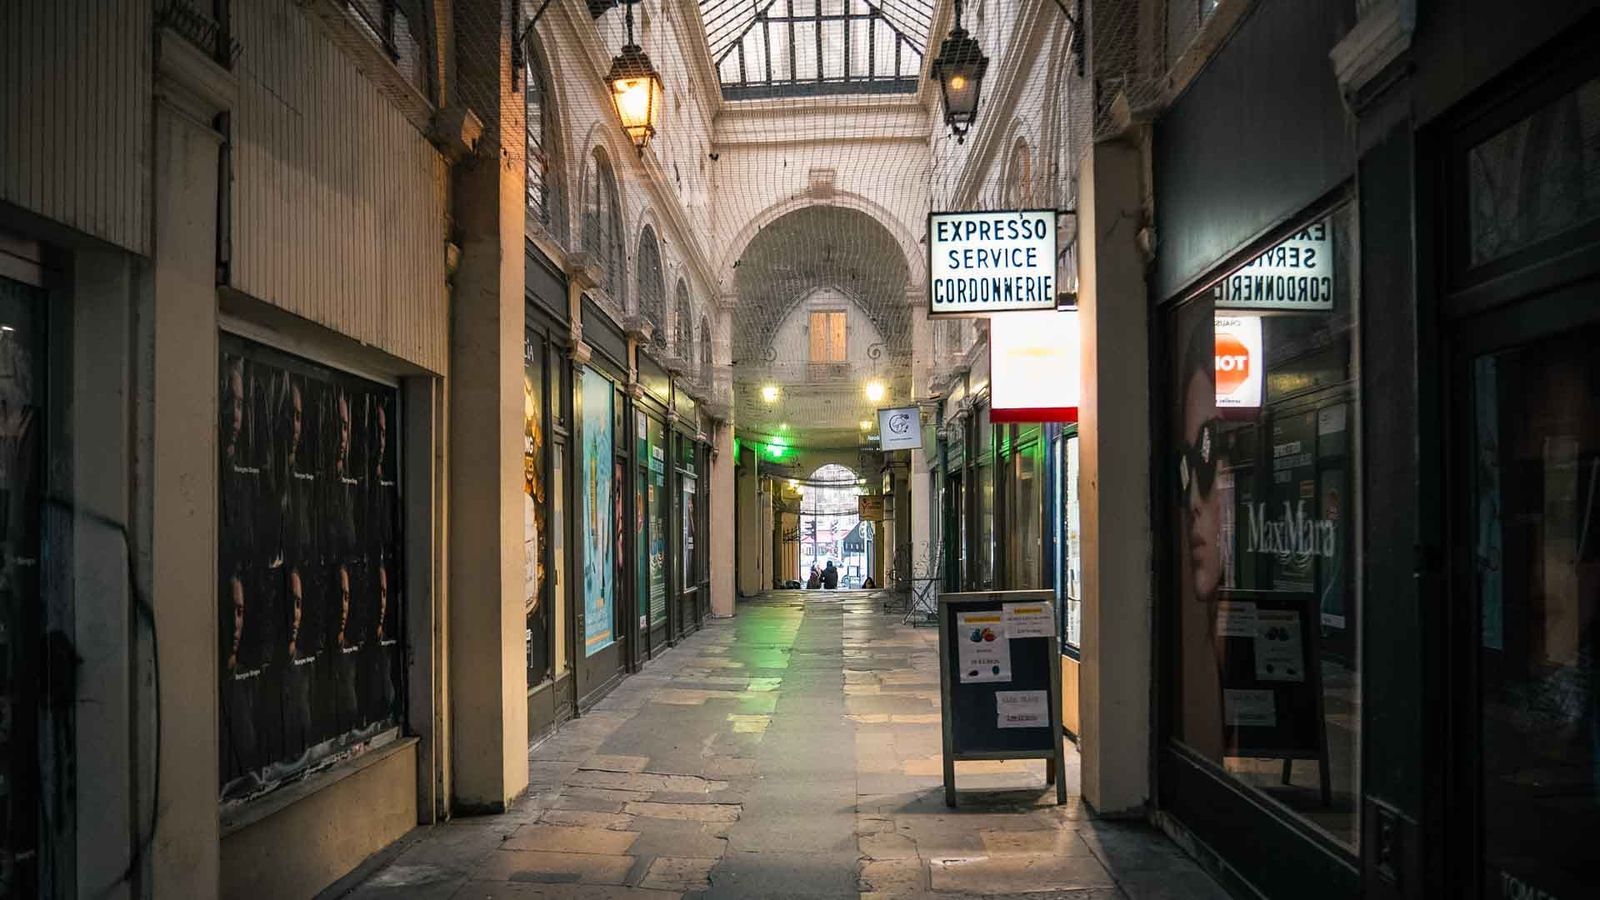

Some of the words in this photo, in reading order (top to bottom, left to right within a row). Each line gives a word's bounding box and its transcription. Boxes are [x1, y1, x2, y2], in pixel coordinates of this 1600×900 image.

[937, 218, 1047, 242] EXPRESSO
[948, 247, 1037, 269] SERVICE
[934, 275, 1053, 304] CORDONNERIE
[1246, 499, 1336, 558] MaxMara
